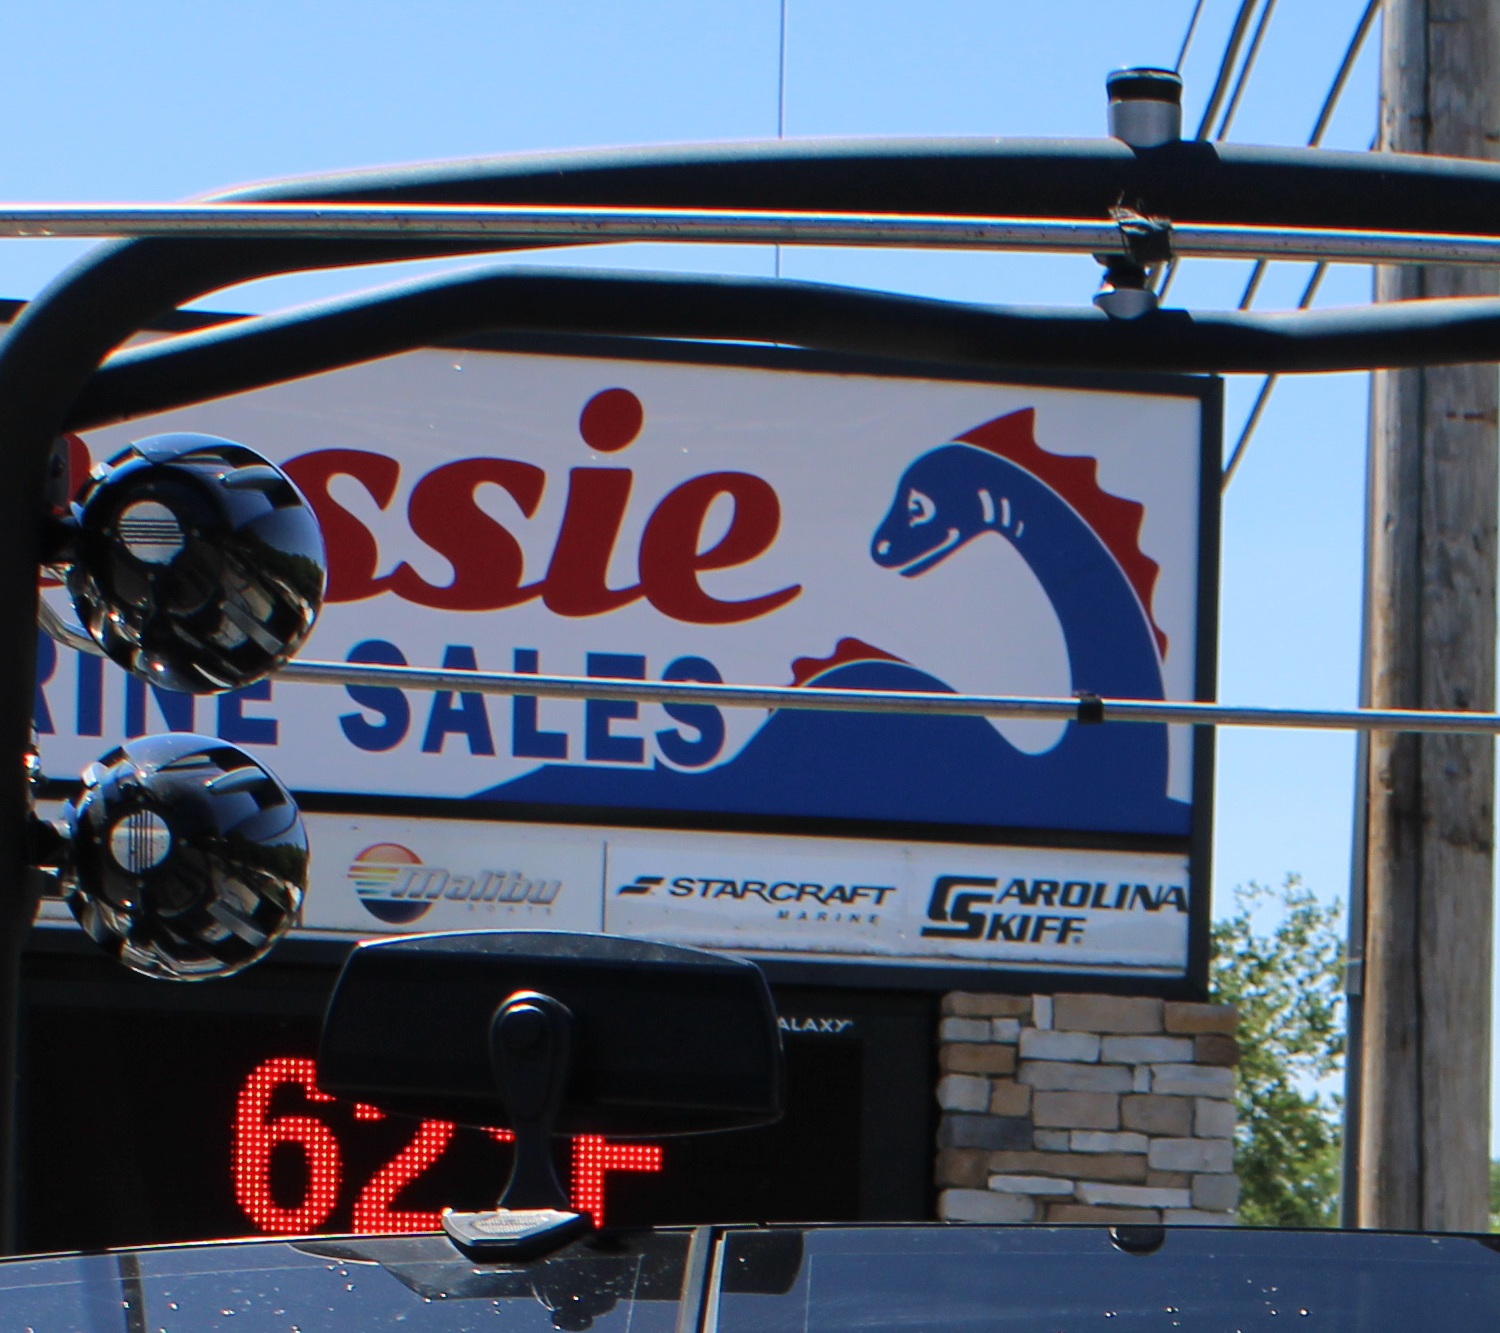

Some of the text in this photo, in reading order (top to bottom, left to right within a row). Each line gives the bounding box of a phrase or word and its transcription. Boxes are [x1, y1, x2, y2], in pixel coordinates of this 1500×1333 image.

[338, 640, 726, 772] SALES
[668, 877, 896, 905] STARCRAFT
[927, 875, 1189, 922] CAROLINA
[776, 909, 879, 926] MARINE
[777, 1016, 854, 1033] ALAXY
